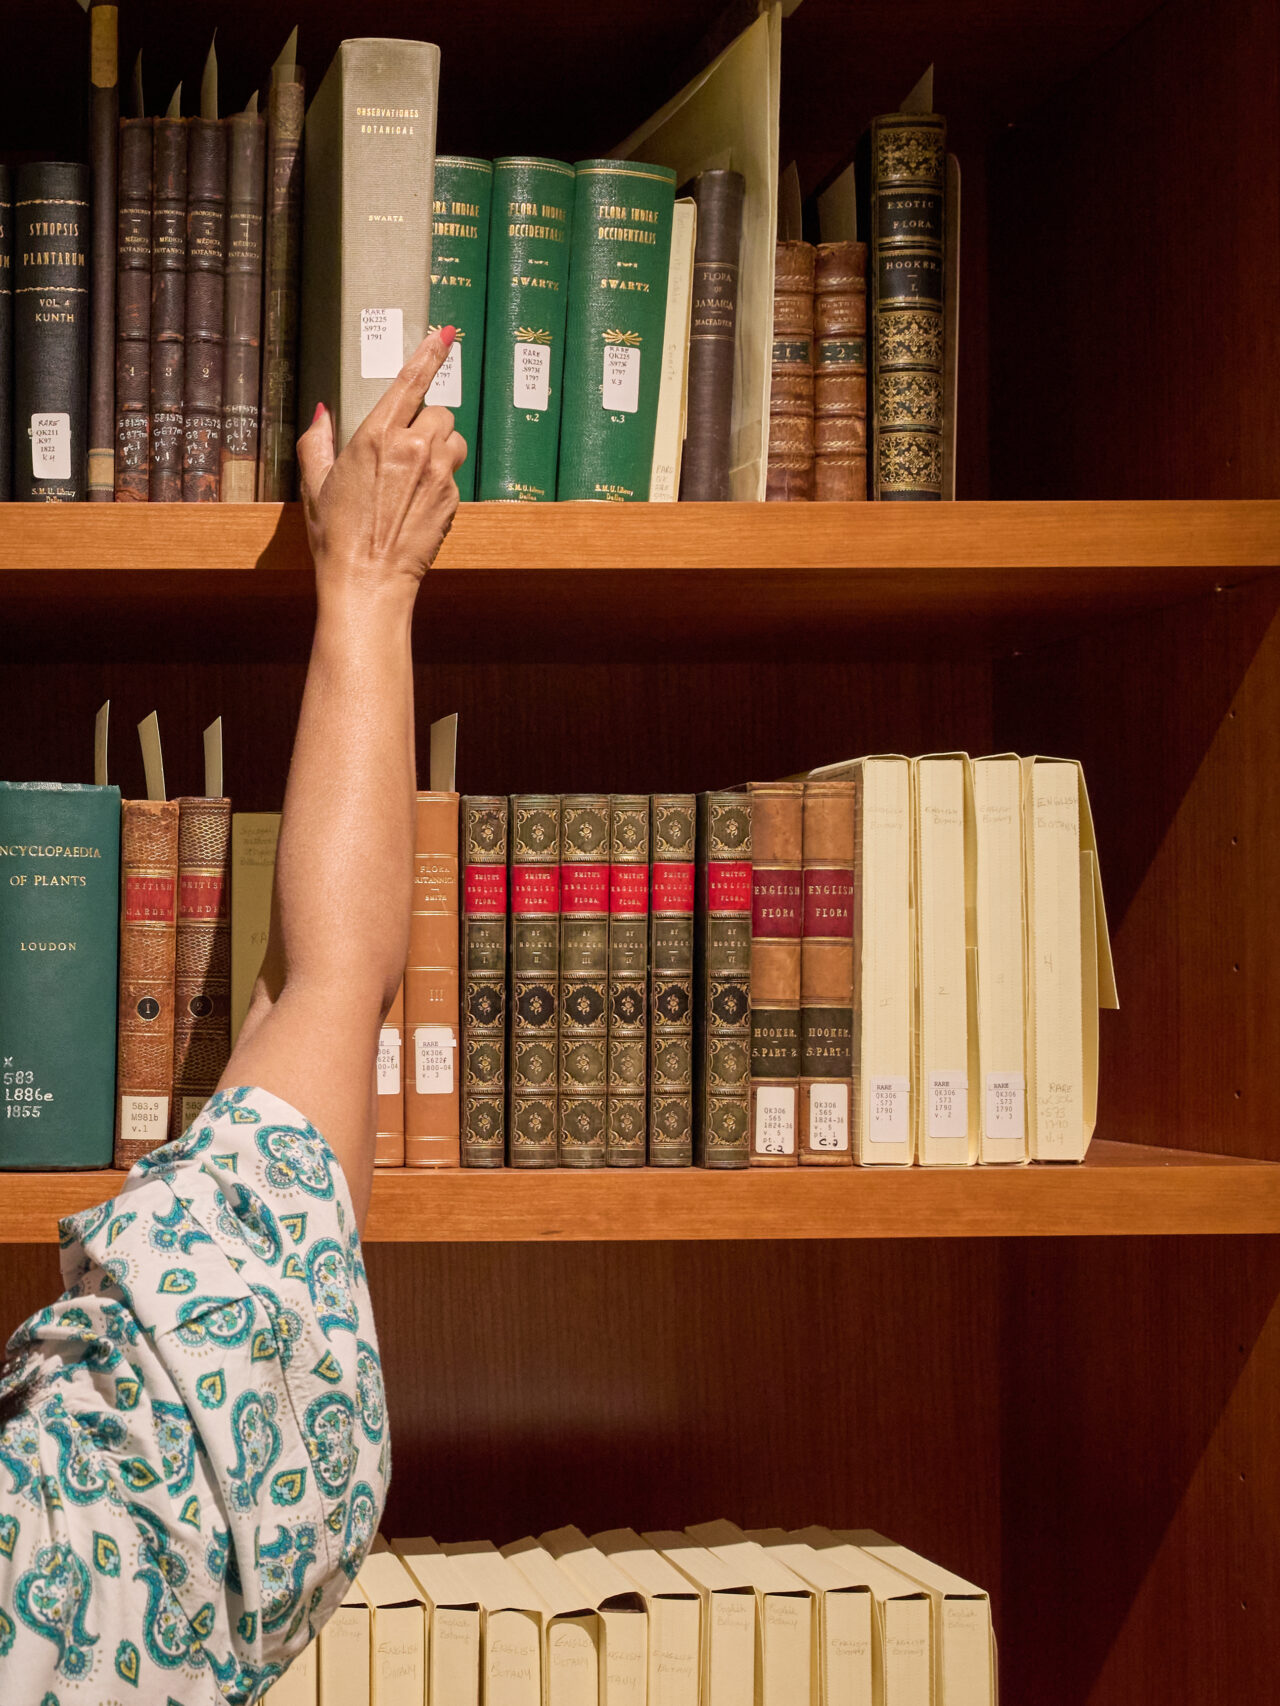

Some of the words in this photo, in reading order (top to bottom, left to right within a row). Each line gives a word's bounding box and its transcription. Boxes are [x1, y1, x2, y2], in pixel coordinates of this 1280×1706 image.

[356, 106, 420, 119] OBSERVATIONES
[361, 125, 415, 136] BOTANICAE
[508, 202, 538, 217] FLORA
[887, 200, 935, 210] EXOTIC
[599, 204, 628, 220] FLORA
[630, 207, 659, 224] INDIAE
[29, 222, 80, 237] SYNOPSIS
[598, 226, 657, 245] OCCIDENTALIS
[23, 251, 86, 267] PLANTARUM
[430, 274, 472, 288] WARTZ
[511, 276, 560, 291] SWARTZ
[702, 272, 732, 284] FLORA
[600, 278, 650, 293] SWARTZ
[694, 298, 734, 311] JAMAICA
[35, 312, 75, 323] KUNTH
[362, 316, 388, 324] QK225
[366, 333, 383, 341] 1791
[837, 347, 845, 358] 2
[521, 358, 544, 366] QK225
[129, 366, 136, 377] 1
[165, 367, 173, 377] 3
[201, 367, 210, 378] 2
[611, 369, 626, 377] 1797
[525, 412, 540, 422] v.2
[610, 413, 625, 423] v.3
[35, 429, 59, 437] QK211
[40, 445, 56, 453] 1822
[420, 865, 451, 874] FLORA
[9, 874, 28, 887] OF
[33, 874, 88, 888] PLANTS
[754, 885, 800, 896] ENGLISH
[808, 884, 854, 896] ENGLISH
[761, 907, 795, 918] FLORA
[815, 907, 849, 918] FLORA
[20, 941, 78, 952] LOUDON
[754, 1028, 798, 1038] HOOKER.
[808, 1027, 851, 1038] HOOKER.
[2, 1070, 35, 1086] 583
[4, 1087, 55, 1102] L886e
[934, 1089, 956, 1098] QK306
[995, 1091, 1017, 1099] QK306
[131, 1101, 160, 1111] 583.9
[763, 1106, 787, 1115] QK306
[814, 1101, 837, 1110] QK306
[875, 1107, 893, 1115] 1790
[934, 1104, 952, 1112] 1790
[995, 1105, 1013, 1113] 1790
[5, 1104, 43, 1119] 1855
[130, 1112, 160, 1123] M981b
[131, 1125, 149, 1134] v.1
